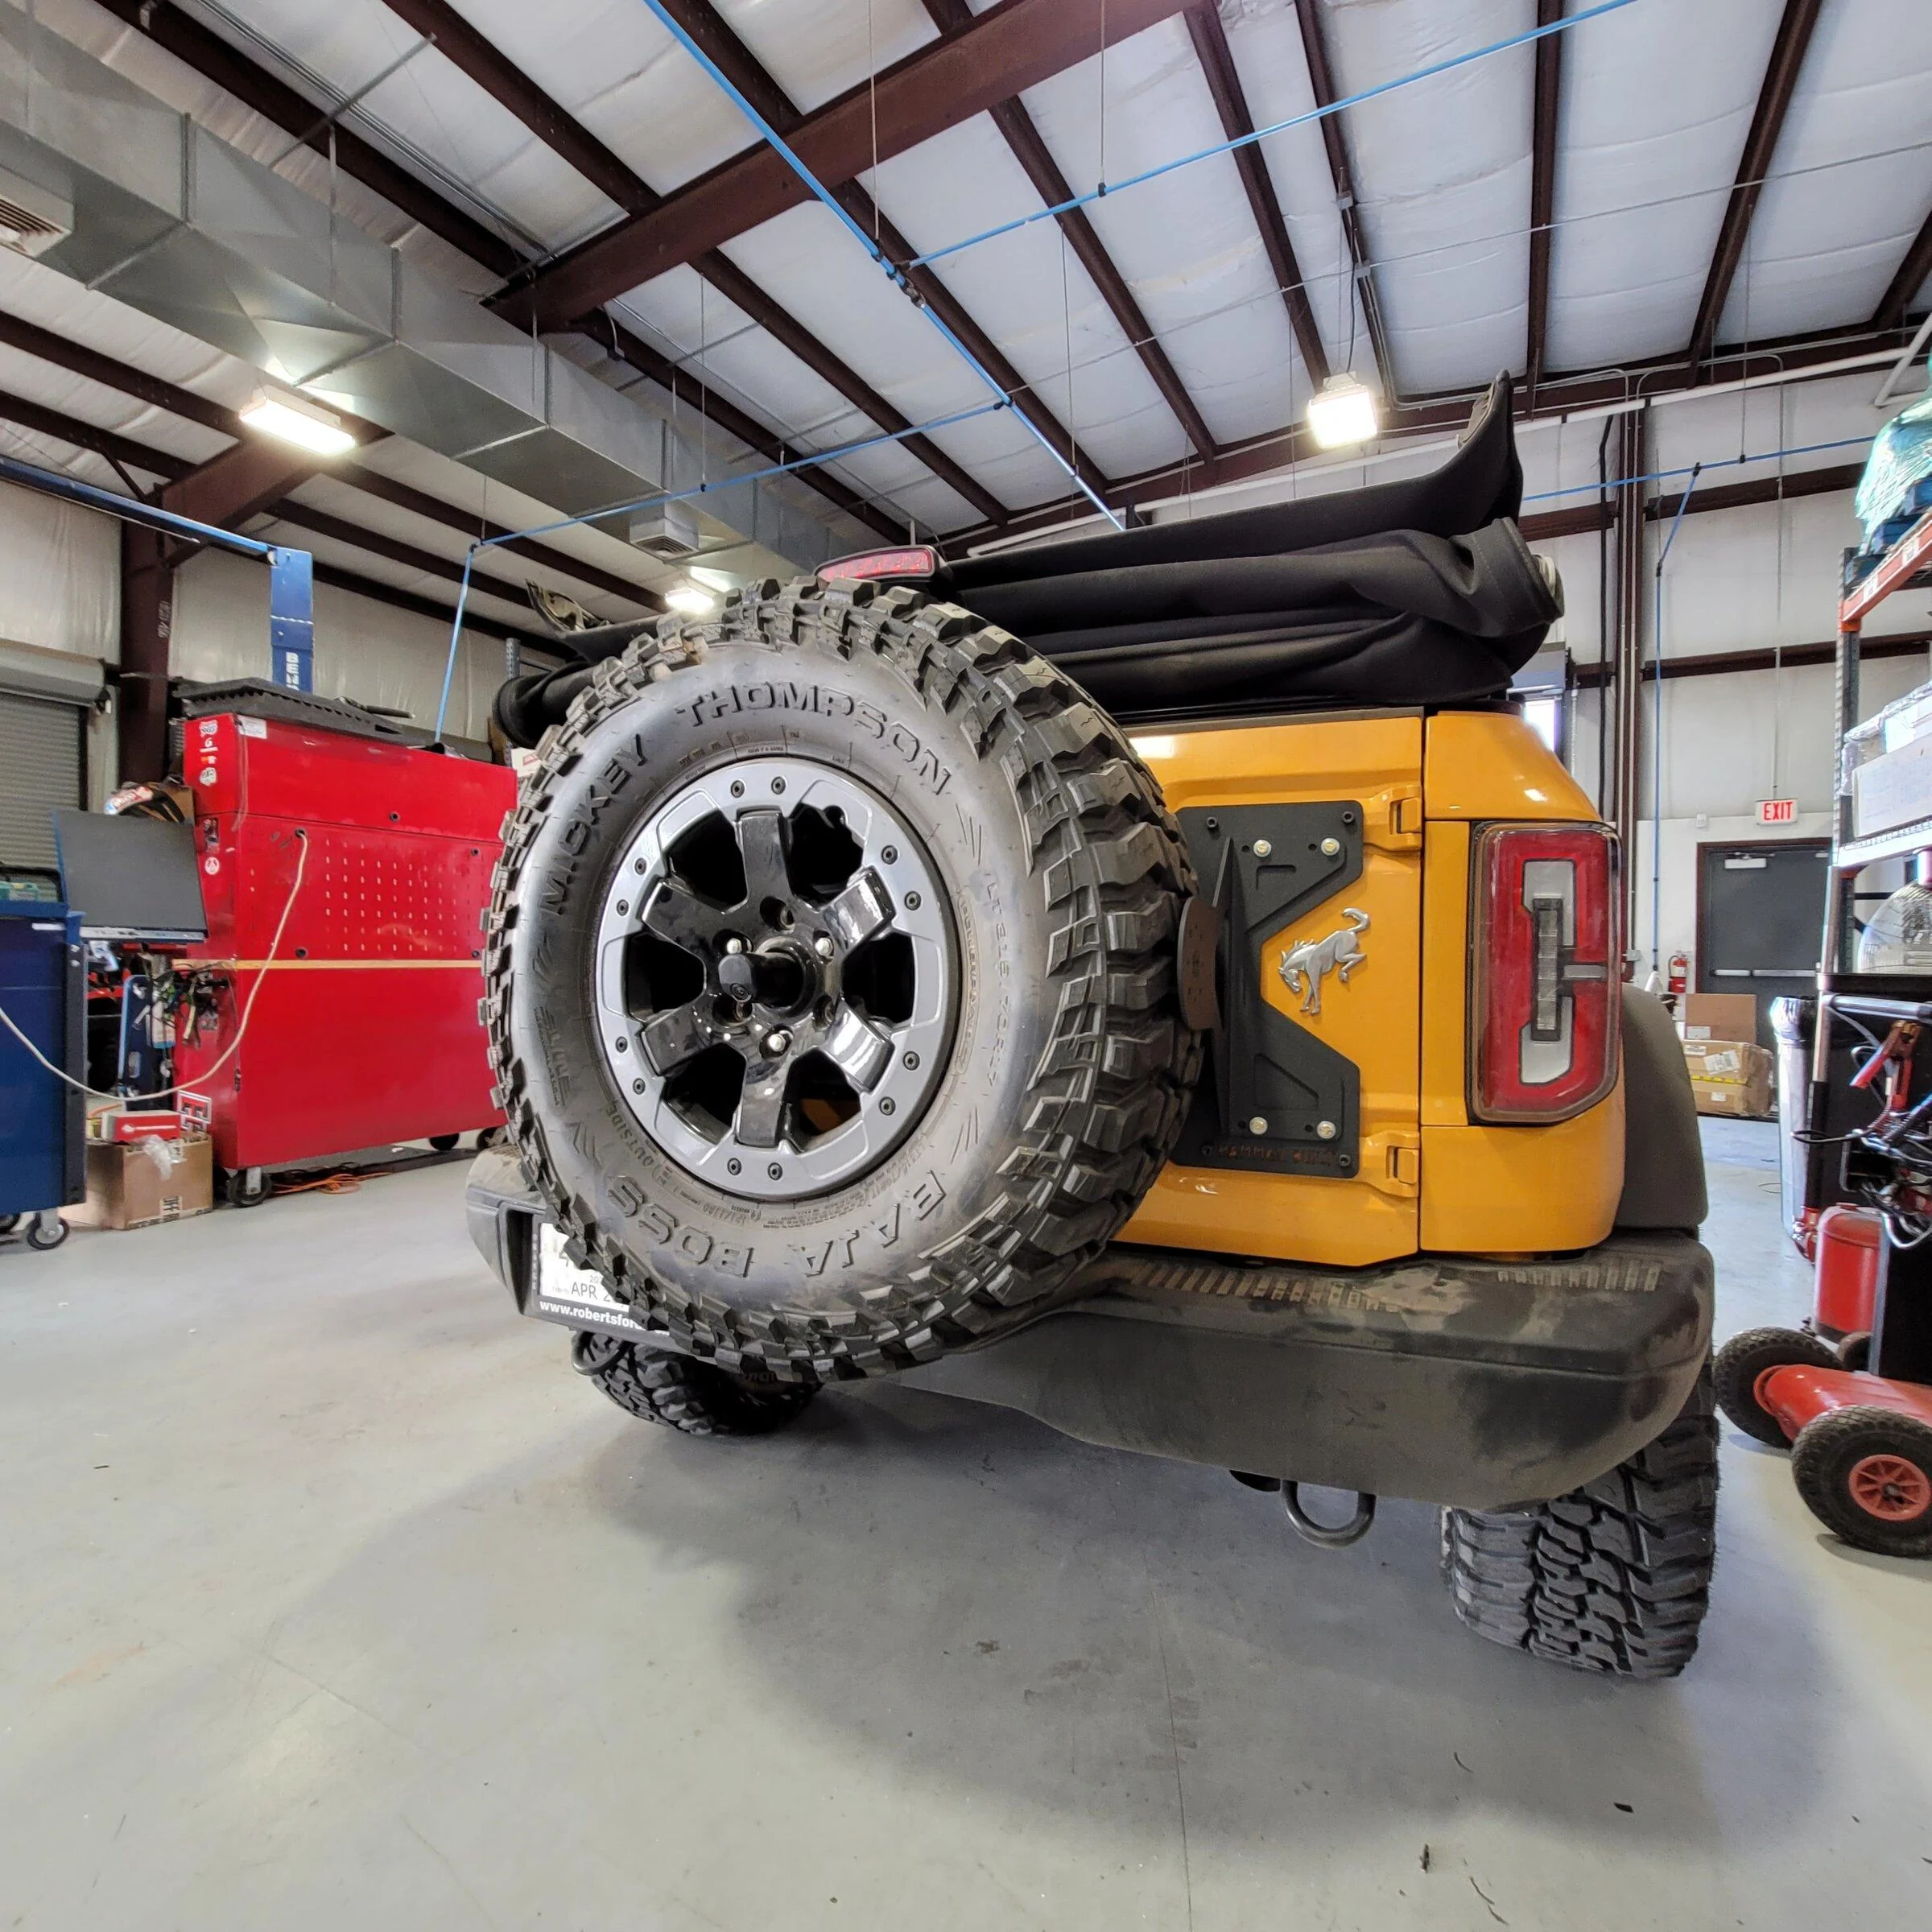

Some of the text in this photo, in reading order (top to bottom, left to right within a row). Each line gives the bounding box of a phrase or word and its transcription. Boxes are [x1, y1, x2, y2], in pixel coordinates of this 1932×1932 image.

[538, 681, 952, 916] MICKEY THOMPSON
[1764, 801, 1793, 820] EXIT
[605, 1100, 654, 1167] OUTSIDE
[607, 1174, 755, 1278] BOSS
[789, 1169, 947, 1278] BAJA
[571, 1282, 597, 1299] APR
